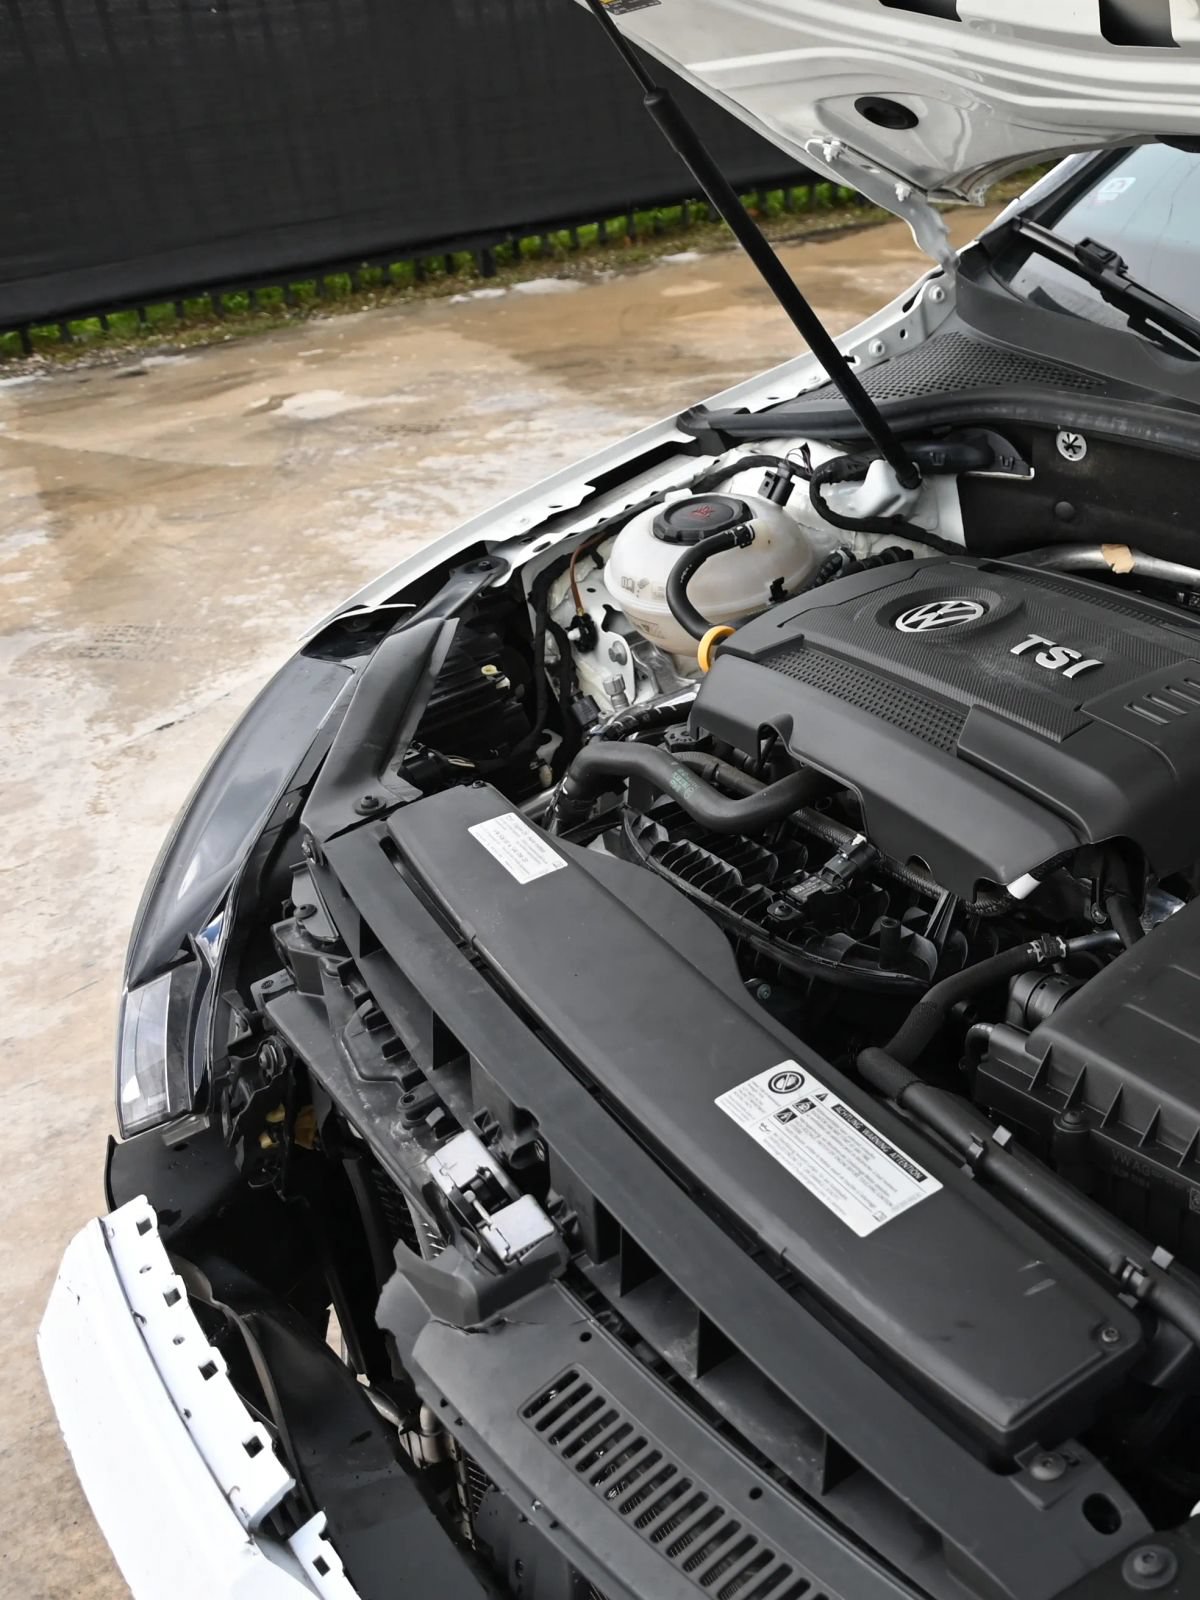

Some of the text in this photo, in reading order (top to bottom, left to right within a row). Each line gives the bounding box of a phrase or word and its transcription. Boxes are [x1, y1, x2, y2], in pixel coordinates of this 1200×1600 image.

[1010, 634, 1104, 679] TSI
[834, 1106, 923, 1179] ACHTUNG WARNING ATTENTION
